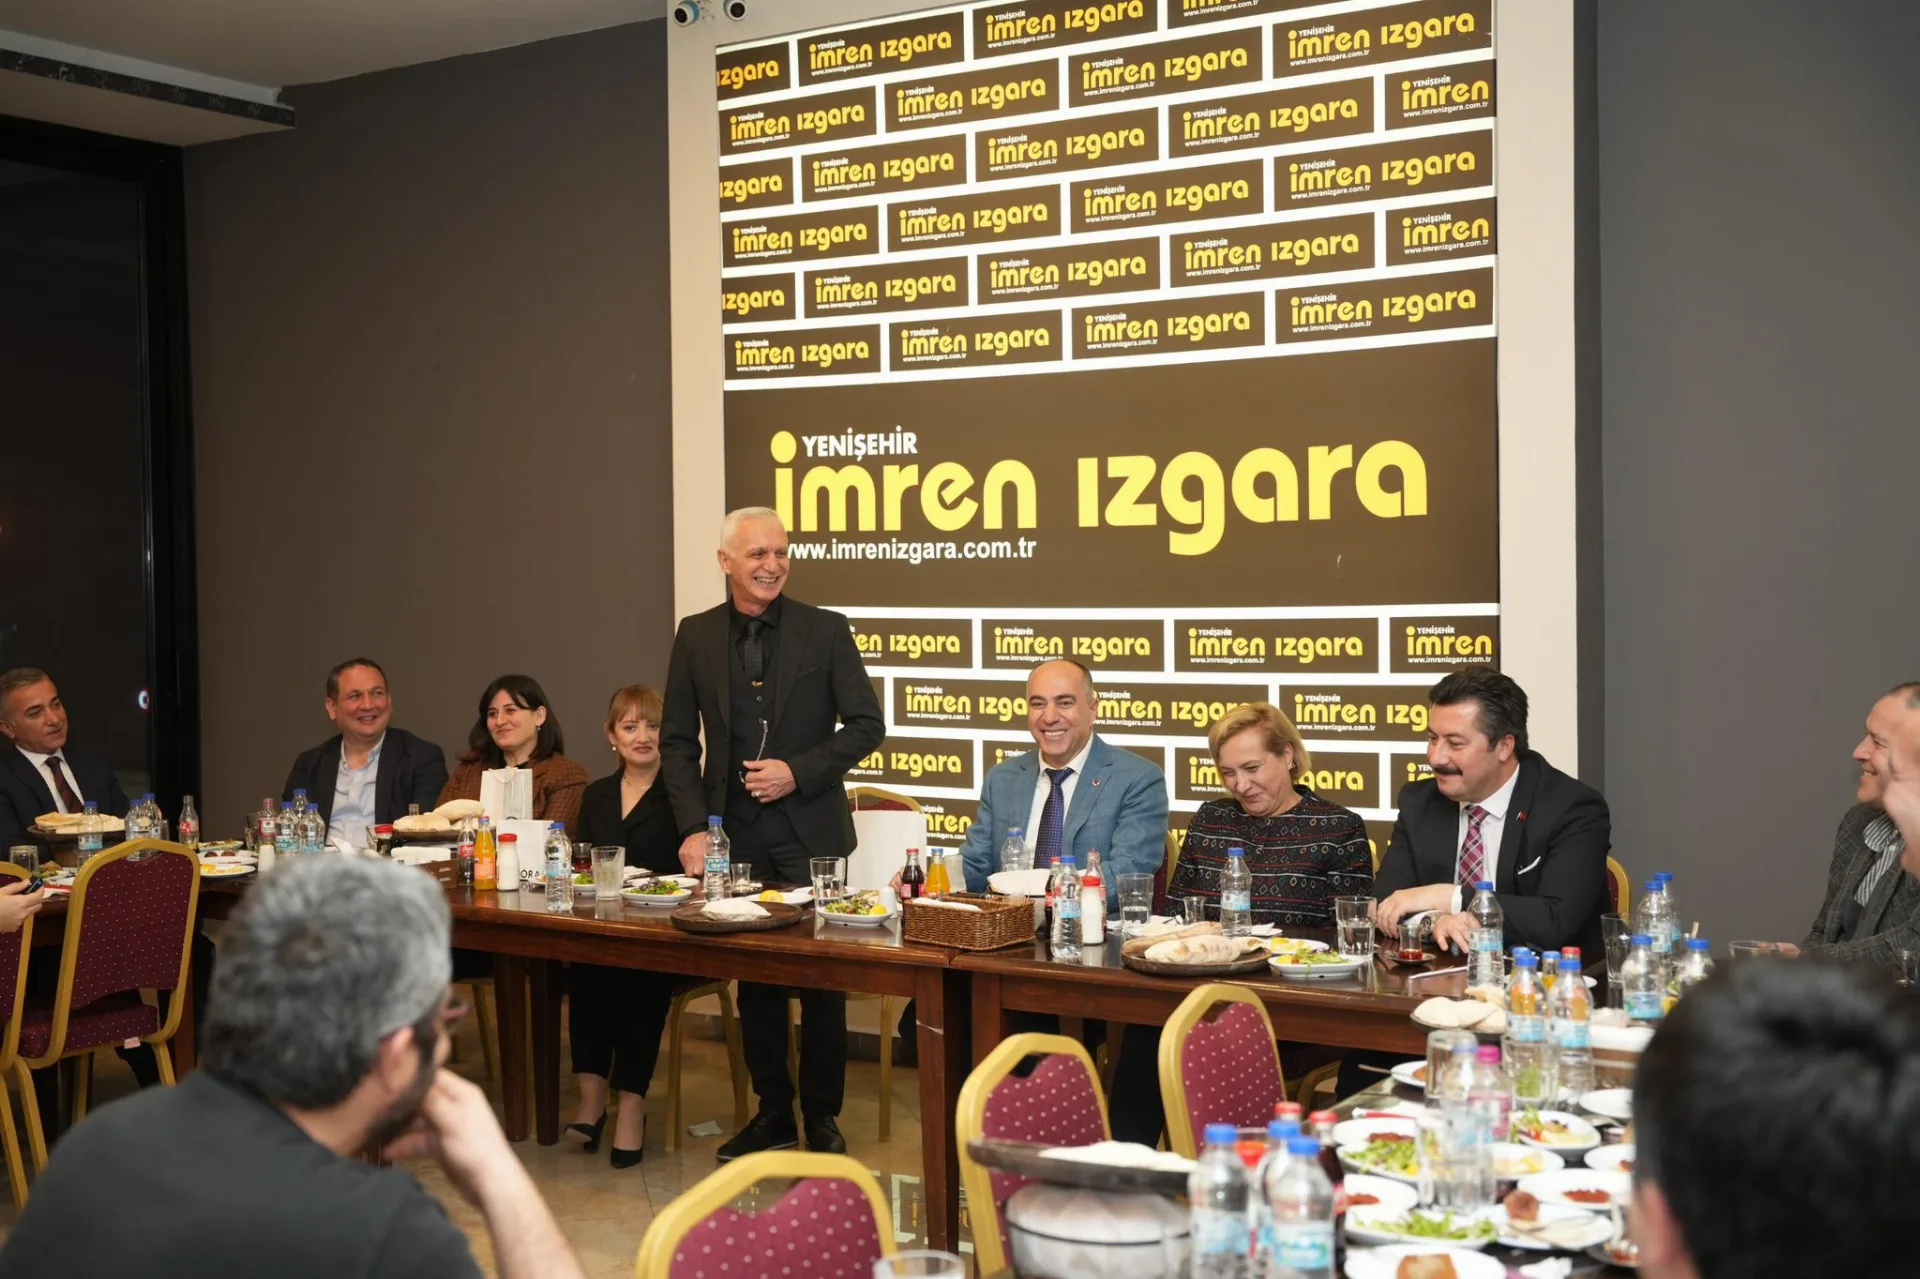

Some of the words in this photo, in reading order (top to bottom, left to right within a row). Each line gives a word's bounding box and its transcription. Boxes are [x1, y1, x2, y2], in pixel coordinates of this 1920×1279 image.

[985, 13, 1055, 41] imren
[1065, 0, 1143, 32] ızgara
[1287, 28, 1370, 58] imren
[1381, 12, 1474, 48] ızgara
[1299, 25, 1334, 36] YENİŞEHİR
[809, 43, 872, 69] imren
[881, 31, 951, 62] ızgara
[1290, 50, 1369, 66] www.imrenizgara.com.tr
[1081, 61, 1155, 89] imren
[1165, 47, 1247, 81] ızgara
[1412, 75, 1451, 87] YENİŞEHİR
[896, 89, 963, 115] imren
[971, 77, 1046, 109] ızgara
[1402, 80, 1489, 110] imren
[1403, 101, 1489, 117] www.imrenizgara.com.tr
[729, 115, 790, 140] imren
[797, 104, 864, 134] ızgara
[1182, 111, 1260, 139] imren
[1270, 98, 1358, 132] ızgara
[1193, 107, 1226, 118] YENİŞEHİR
[987, 137, 1057, 164] imren
[1066, 127, 1144, 159] ızgara
[1185, 132, 1259, 146] www.imrenizgara.com.tr
[812, 160, 876, 186] imren
[883, 152, 954, 182] ızgara
[1288, 162, 1371, 192] imren
[1382, 151, 1475, 185] ızgara
[1300, 159, 1335, 170] YENİŞEHİR
[1083, 188, 1156, 216] imren
[1166, 179, 1248, 211] ızgara
[1291, 185, 1370, 199] www.imrenizgara.com.tr
[898, 209, 965, 236] imren
[973, 202, 1048, 233] ızgara
[1402, 217, 1489, 247] imren
[1413, 212, 1452, 225] YENİŞEHİR
[732, 227, 793, 252] imren
[800, 222, 867, 251] ızgara
[1183, 241, 1261, 269] imren
[1271, 233, 1359, 266] ızgara
[1195, 238, 1228, 248] YENİŞEHİR
[1404, 238, 1489, 254] www.imrenizgara.com.tr
[989, 260, 1059, 287] imren
[1068, 255, 1146, 286] ızgara
[1186, 264, 1260, 276] www.imrenizgara.com.tr
[814, 277, 877, 303] imren
[886, 274, 956, 302] ızgara
[1301, 293, 1337, 304] YENİŞEHİR
[1290, 296, 1372, 325] imren
[1383, 289, 1475, 322] ızgara
[1084, 314, 1158, 342] imren
[1168, 310, 1250, 341] ızgara
[1293, 321, 1371, 332] www.imrenizgara.com.tr
[735, 341, 794, 366] imren
[802, 340, 870, 367] ızgara
[900, 329, 967, 355] imren
[975, 327, 1049, 356] ızgara
[801, 425, 918, 461] YENİŞEHİR
[771, 430, 1037, 532] imren
[1077, 439, 1428, 556] ızgara
[994, 627, 1064, 655] imren
[1072, 637, 1151, 662] ızgara
[1198, 628, 1232, 637] YENİŞEHİR
[1406, 626, 1492, 656] imren
[1416, 625, 1455, 635] YENİŞEHİR
[889, 634, 961, 659] ızgara
[1188, 627, 1266, 657] imren
[1275, 637, 1364, 663] ızgara
[1190, 657, 1265, 665] www.imrenizgara.com.tr
[1408, 656, 1492, 664] www.imrenizgara.com.tr
[905, 685, 971, 713] imren
[979, 696, 1028, 722] ızga
[1093, 690, 1162, 719] mren
[1294, 694, 1376, 724] imren
[1305, 693, 1341, 704] YENİŞEHİR
[1296, 723, 1376, 731] www.imrenizgara.com.tr
[891, 752, 962, 778] ızgara
